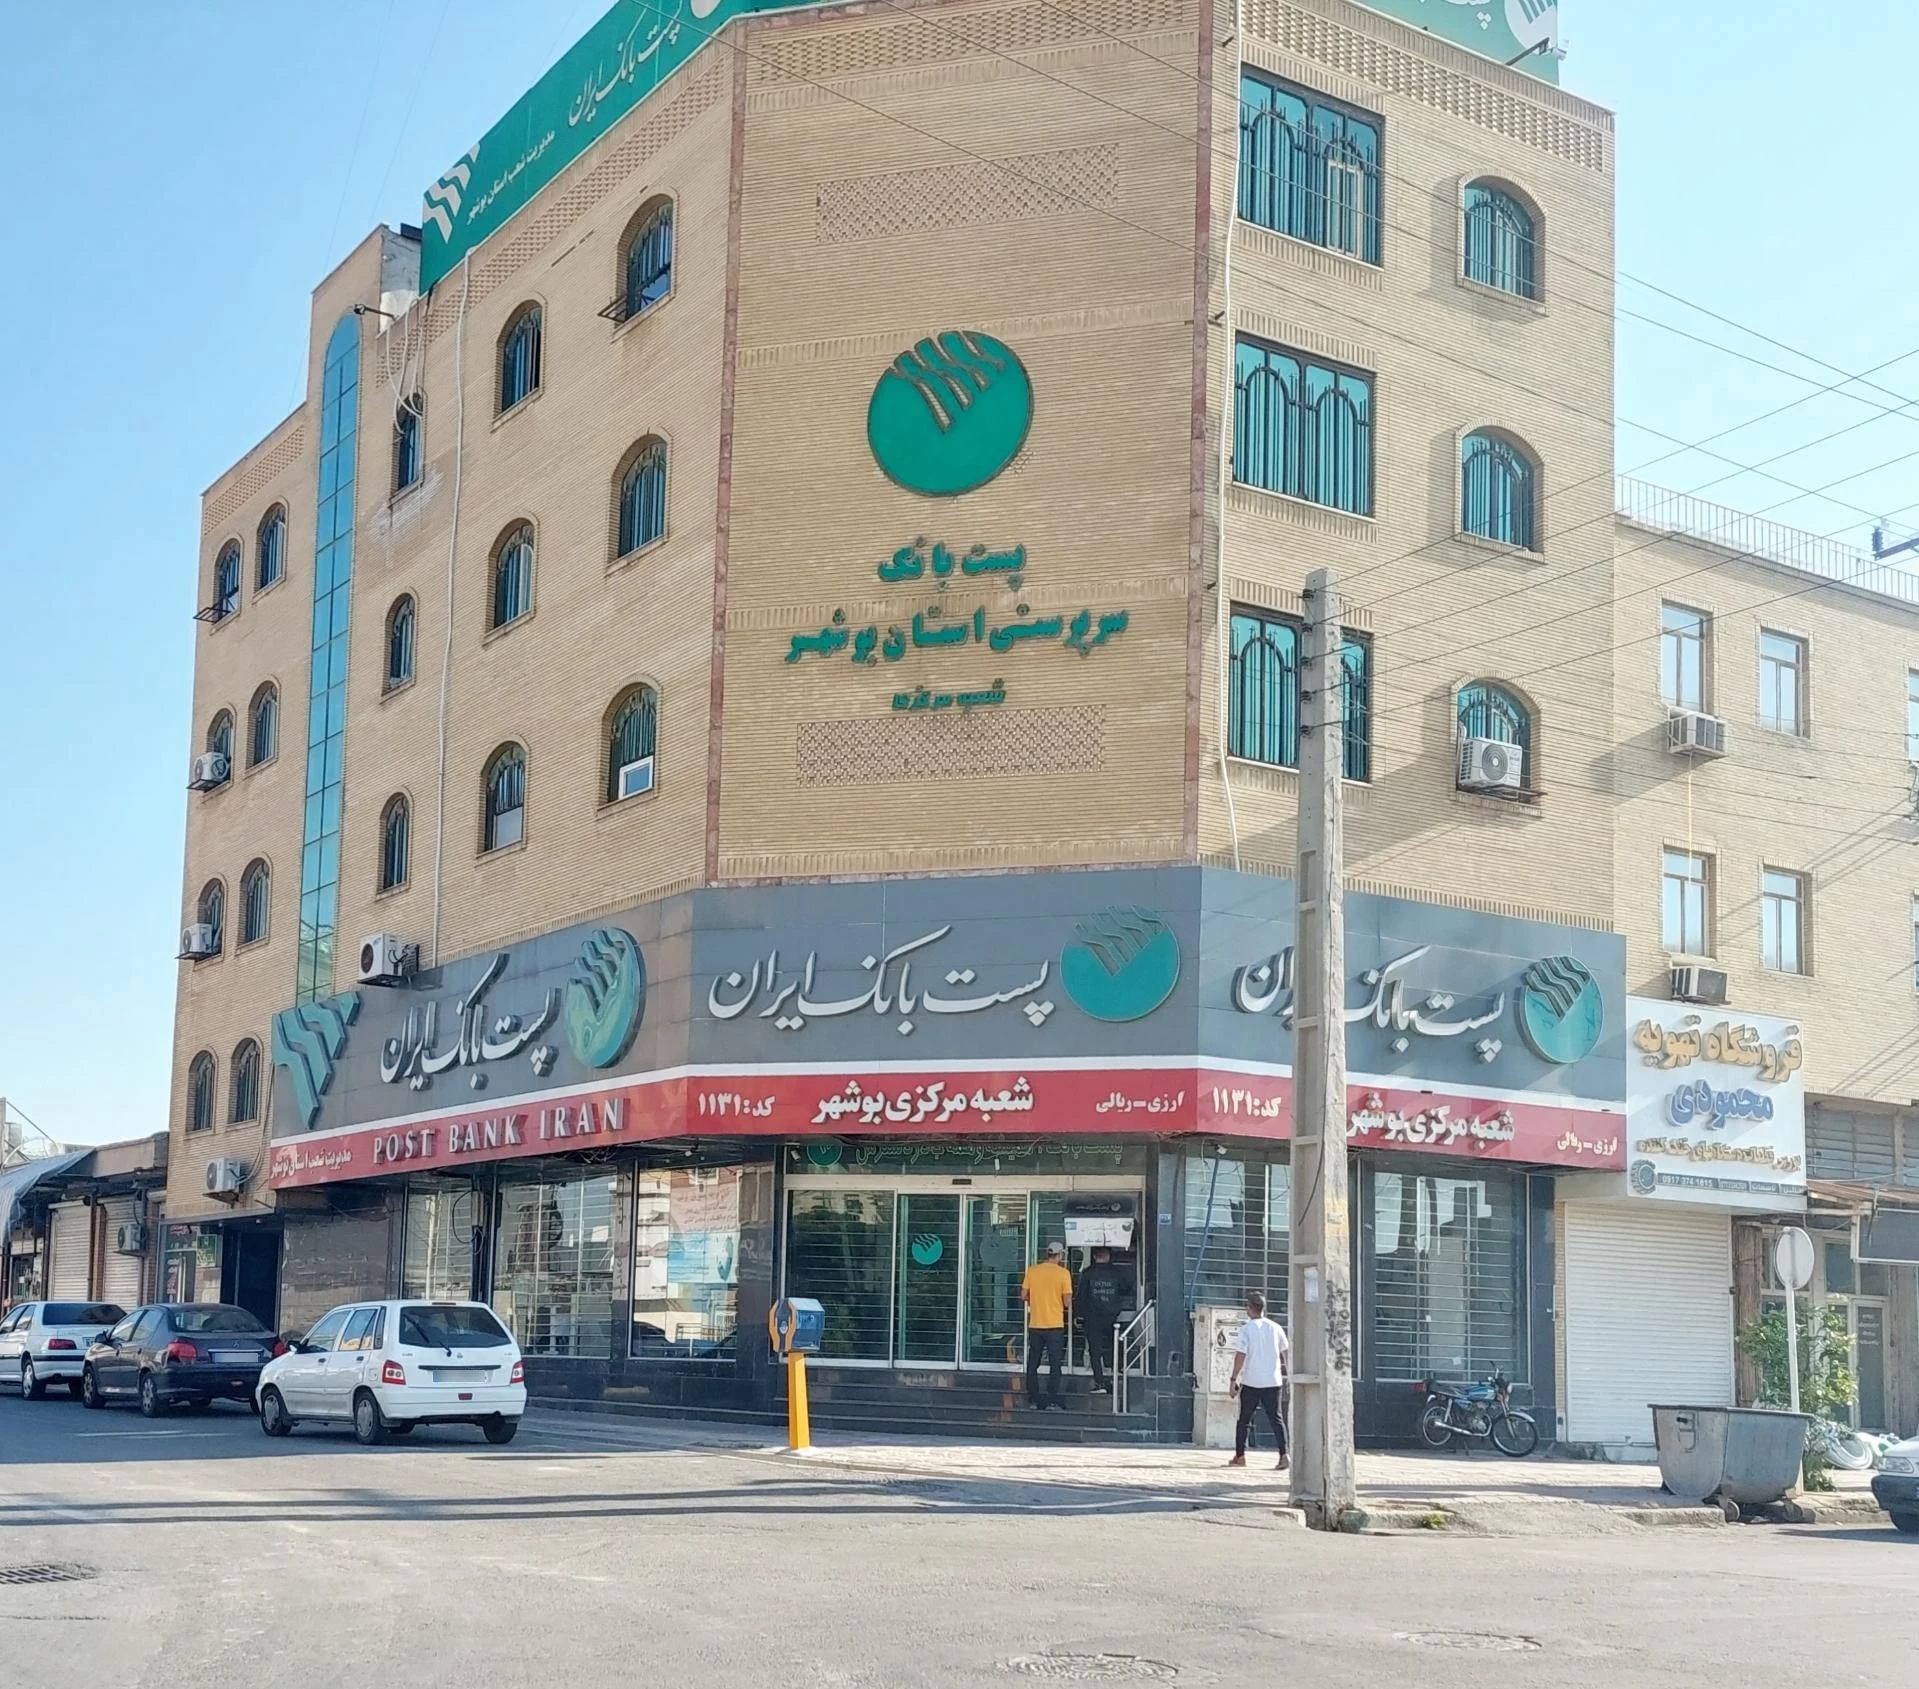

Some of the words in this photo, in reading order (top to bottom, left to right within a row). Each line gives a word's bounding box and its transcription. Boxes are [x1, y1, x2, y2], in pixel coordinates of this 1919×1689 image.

[877, 535, 955, 592] بانک
[961, 542, 1027, 592] پست
[784, 607, 878, 668] بوشهر
[882, 604, 986, 662] استان
[988, 602, 1129, 660] سرپرستی
[956, 678, 1007, 712] شعبه
[707, 949, 817, 1032] ایران
[798, 924, 952, 1036] بانک
[922, 959, 1056, 1028] پست
[1344, 944, 1432, 1054] بانک
[381, 1001, 438, 1091] ایران
[421, 952, 509, 1090] بانک
[481, 987, 560, 1076] پست
[1409, 991, 1505, 1065] پست
[1701, 1021, 1802, 1083] فروشگاه
[810, 1078, 885, 1125] بوشهر
[884, 1081, 968, 1123] مرکزی
[969, 1076, 1034, 1124] شعبه
[1346, 1092, 1404, 1142] بوشهر
[1404, 1105, 1468, 1145] مرکزی
[1665, 1079, 1774, 1131] محمودی
[372, 1129, 434, 1165] POST
[449, 1113, 527, 1154] BANK
[539, 1097, 631, 1140] IRAN
[1470, 1110, 1515, 1150] شعبه
